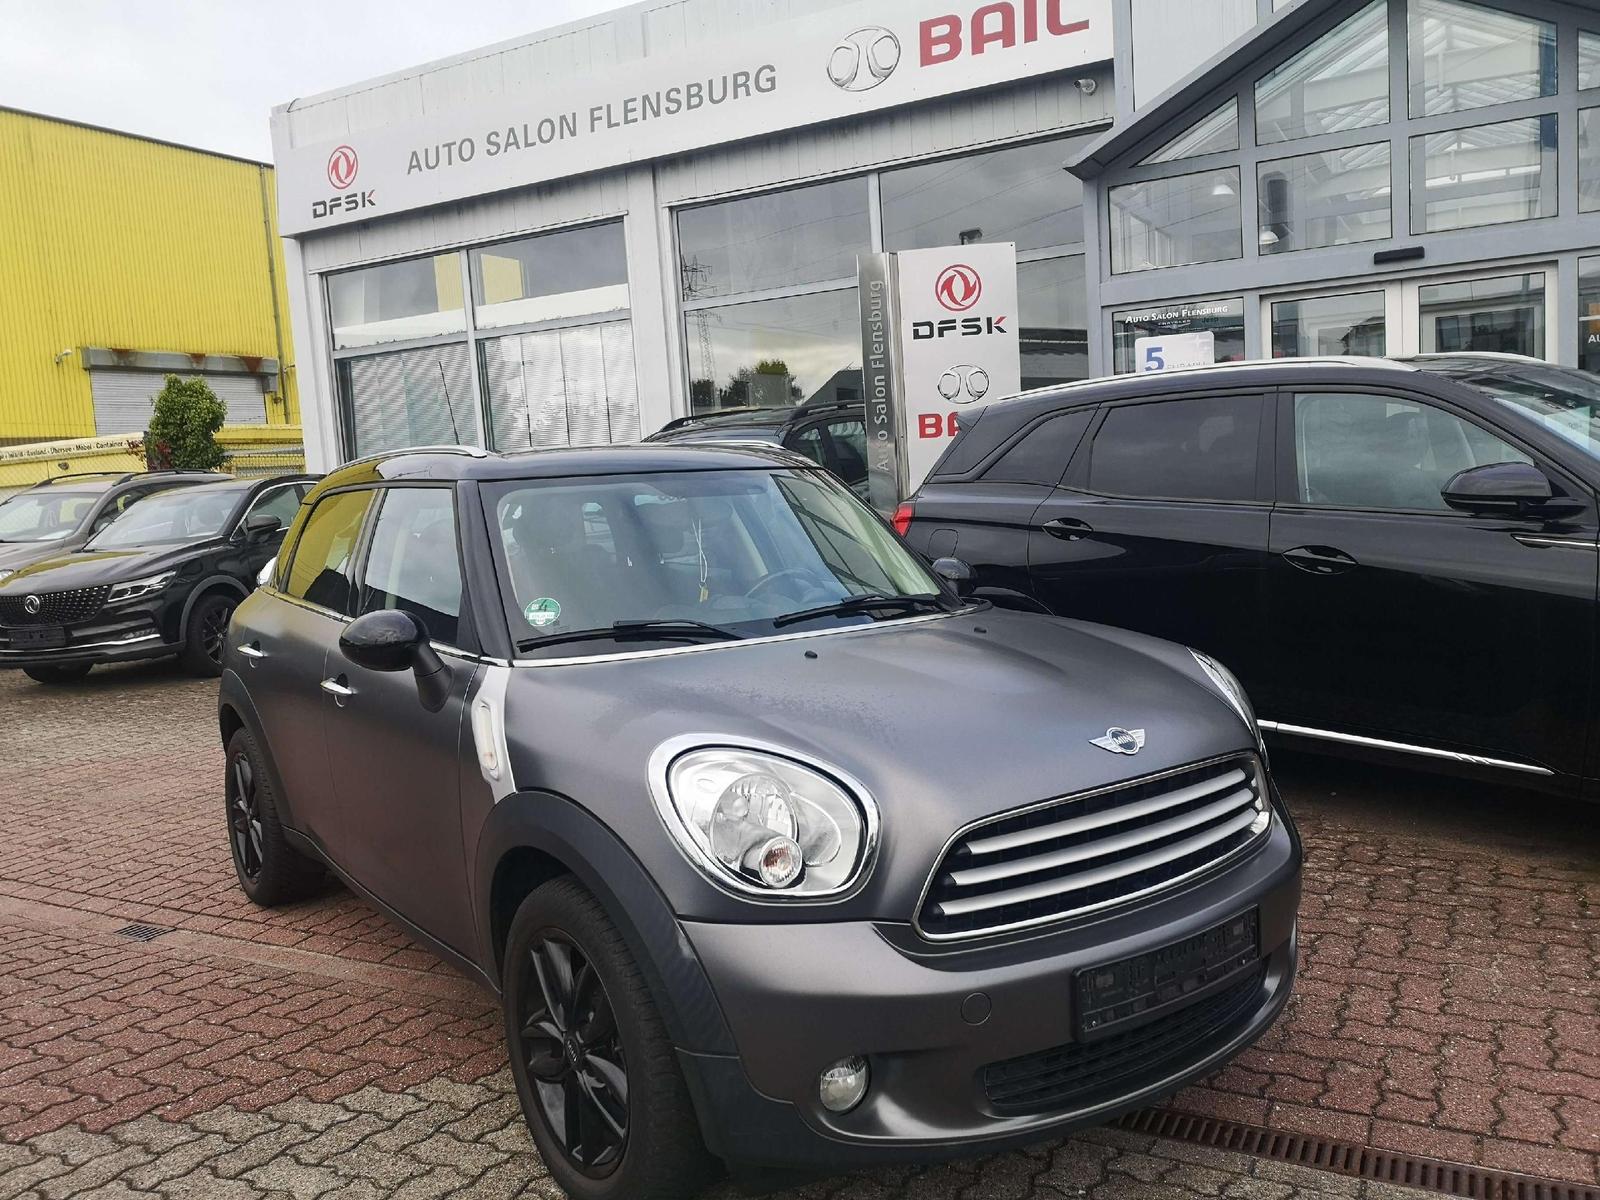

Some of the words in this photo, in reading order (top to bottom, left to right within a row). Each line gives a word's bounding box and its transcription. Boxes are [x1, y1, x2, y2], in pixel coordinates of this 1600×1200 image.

[406, 137, 476, 175] AUTO
[485, 111, 578, 158] SALON
[588, 64, 778, 135] FLENSBURG
[311, 188, 376, 220] DFSK
[868, 280, 886, 368] Flensburg
[912, 316, 1007, 340] DFSK
[1144, 347, 1165, 371] 5
[871, 375, 888, 425] Salon
